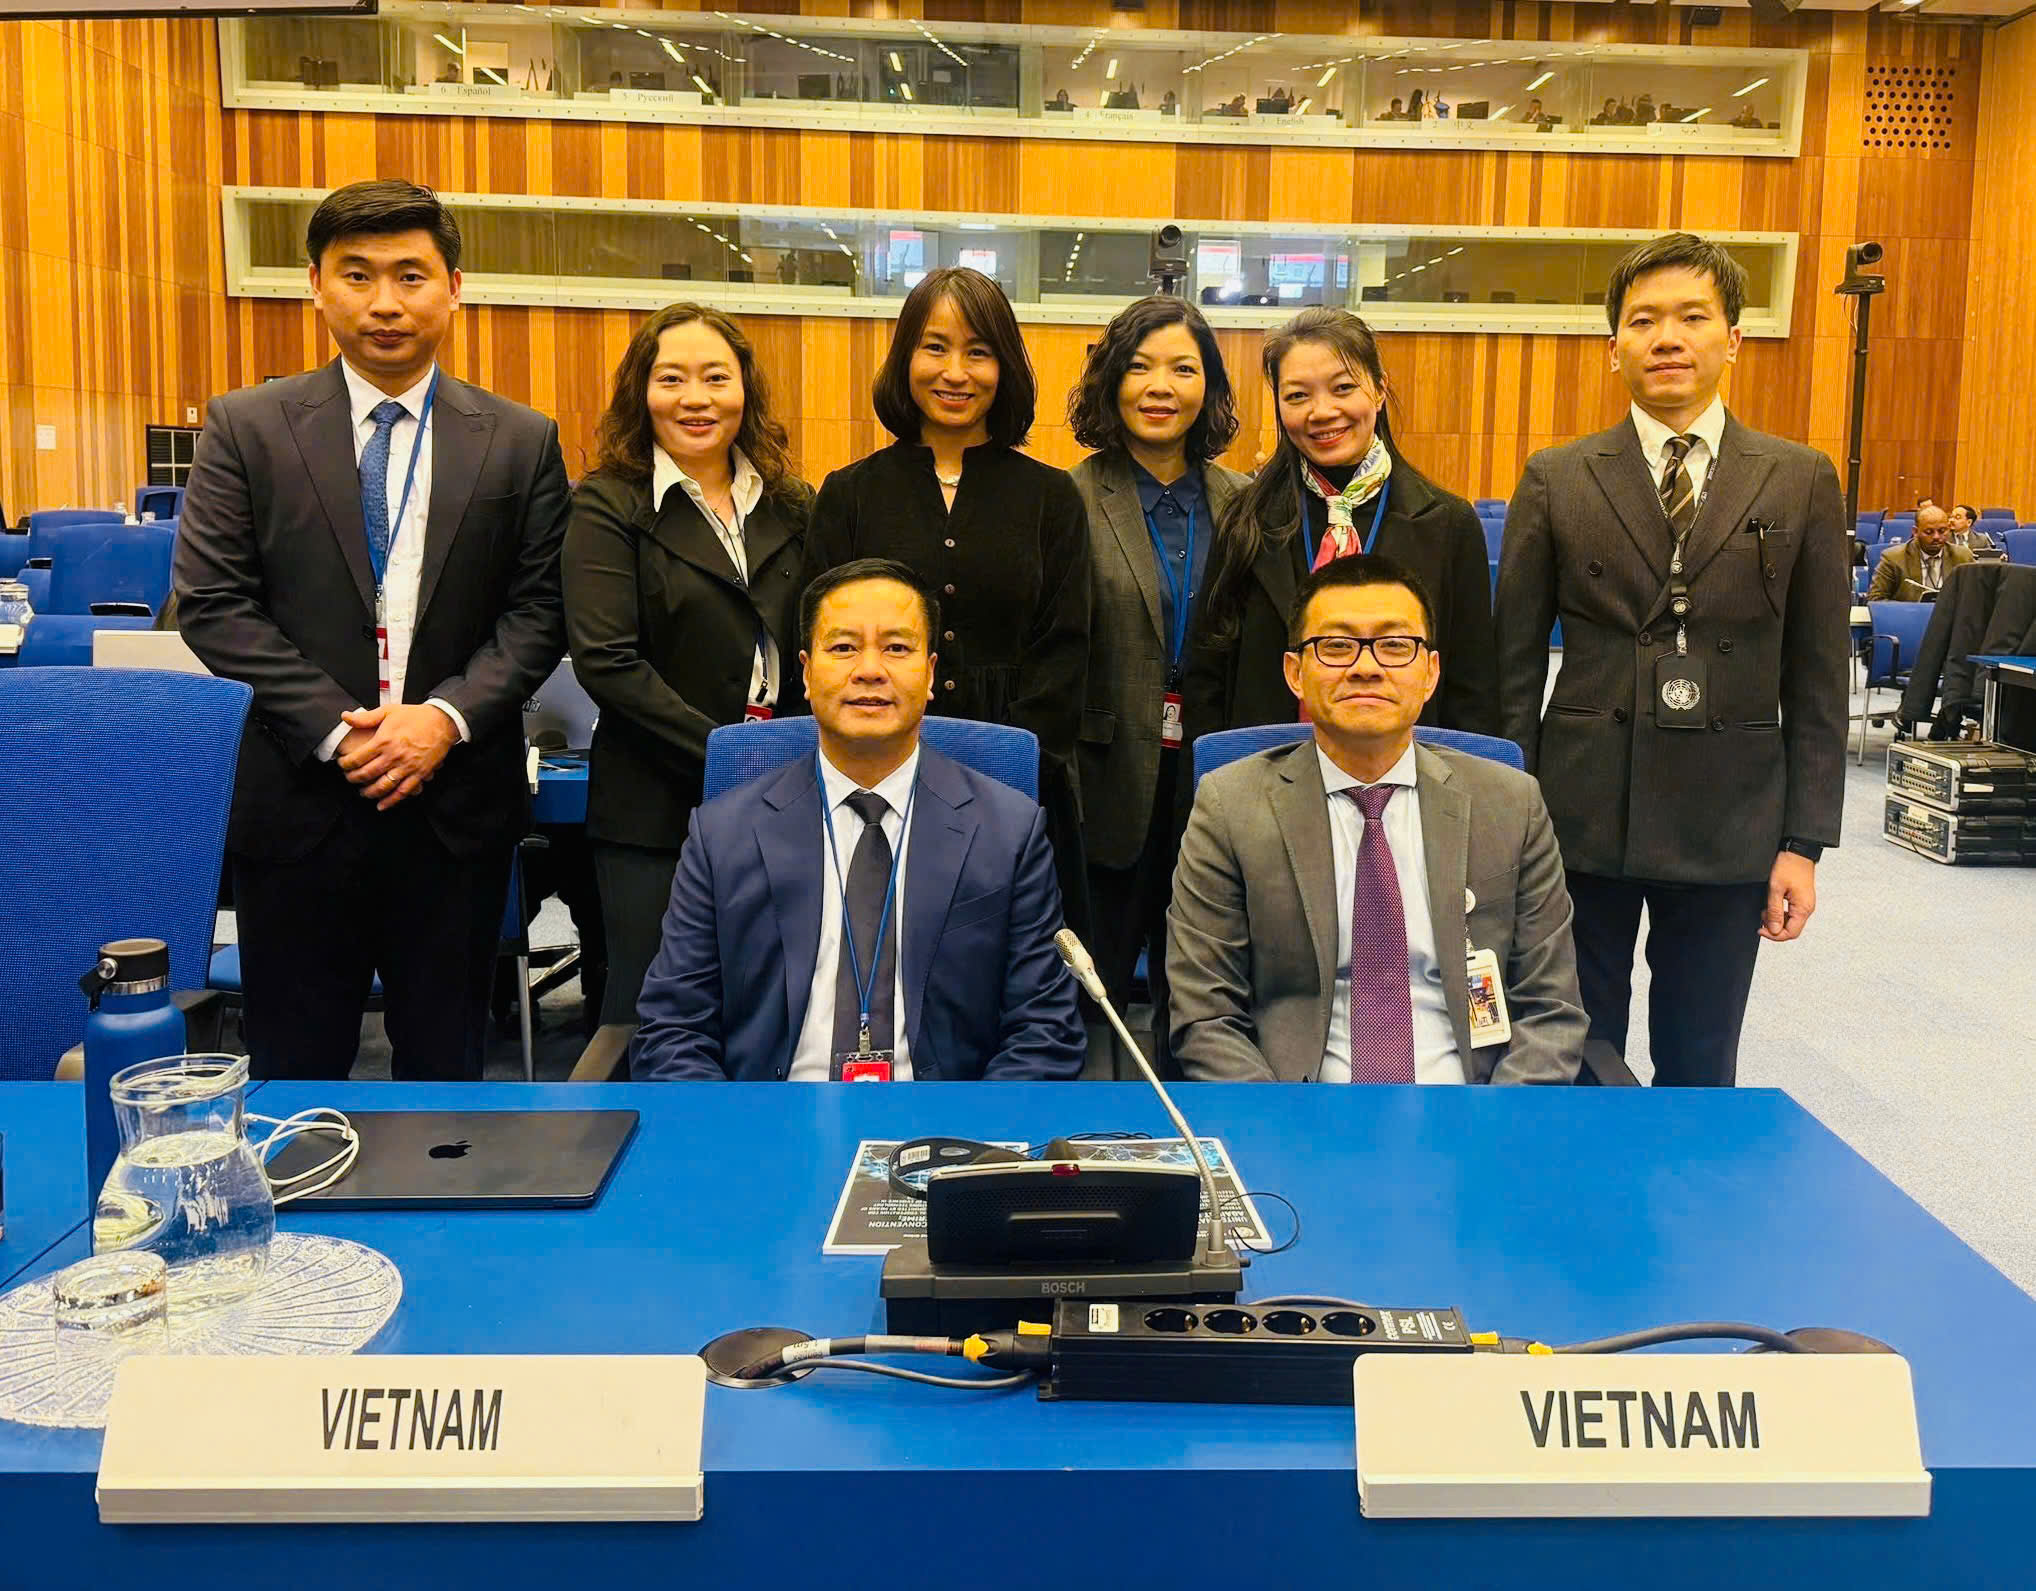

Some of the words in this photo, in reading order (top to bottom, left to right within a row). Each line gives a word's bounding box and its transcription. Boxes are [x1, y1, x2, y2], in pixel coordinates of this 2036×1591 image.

[457, 86, 491, 96] Español
[638, 93, 673, 103] Русский
[1100, 110, 1134, 121] Français
[1041, 1281, 1085, 1294] BOSCH
[322, 1388, 503, 1451] VIETNAM
[1520, 1390, 1760, 1449] VIETNAM
